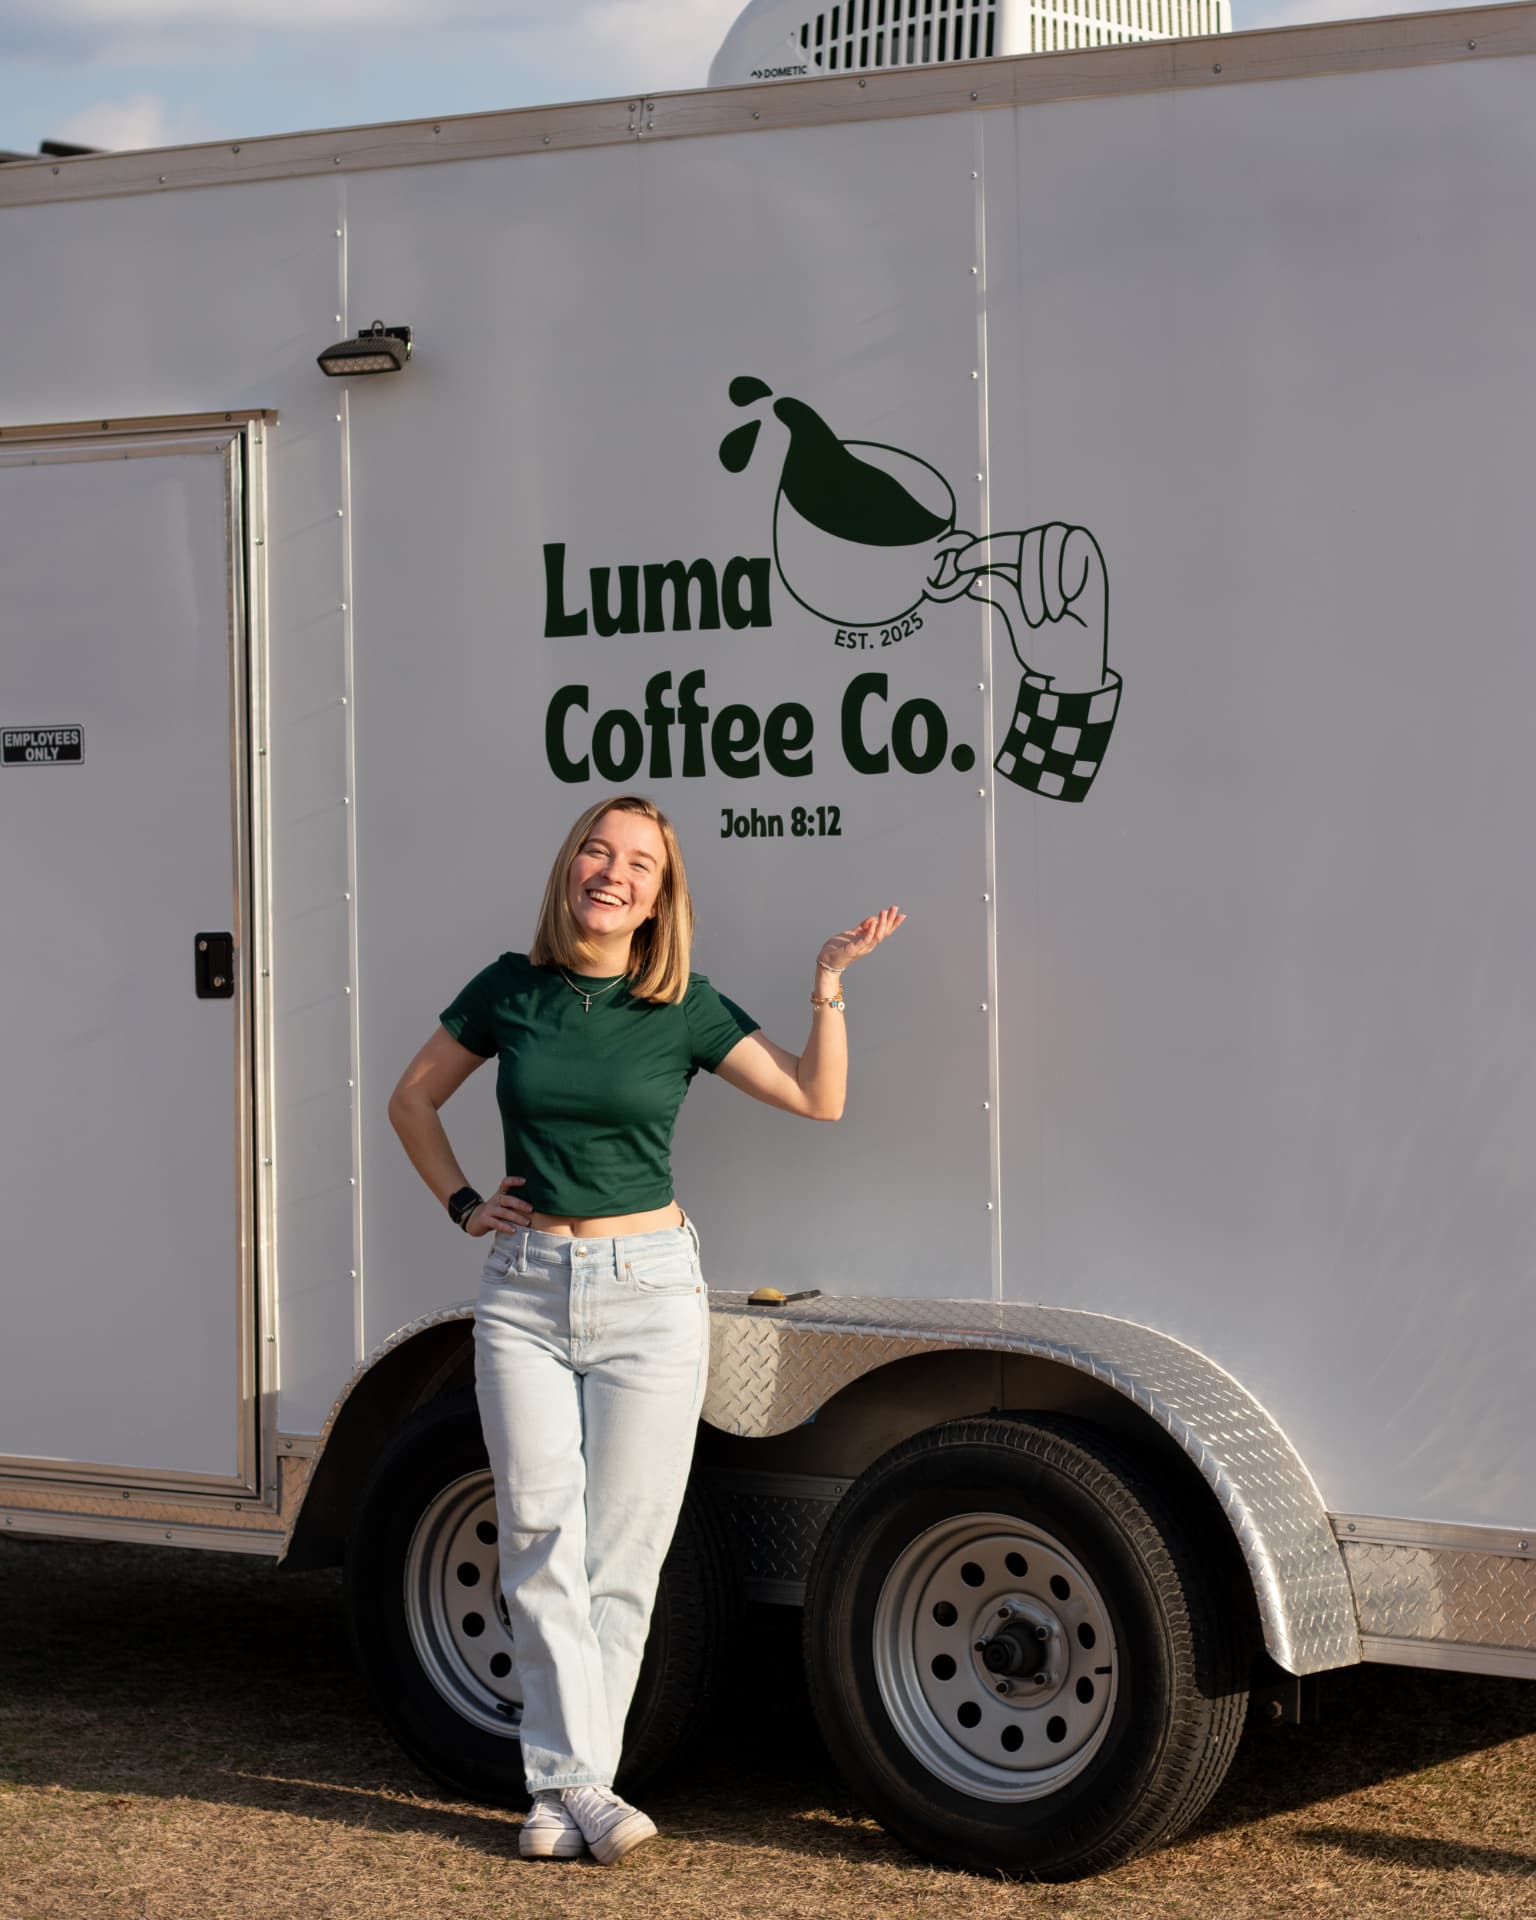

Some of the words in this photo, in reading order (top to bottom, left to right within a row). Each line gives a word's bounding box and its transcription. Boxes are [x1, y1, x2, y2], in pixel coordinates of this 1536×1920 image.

[764, 65, 807, 78] DOMETIC
[542, 543, 773, 638] Luma
[834, 629, 874, 649] EST.
[880, 611, 924, 648] 2025
[4, 731, 79, 747] EMPLOYEES
[545, 669, 814, 784] Coffee
[840, 672, 976, 775] Co.
[25, 747, 59, 761] ONLY
[720, 807, 784, 839] John
[790, 805, 842, 837] 8:12
